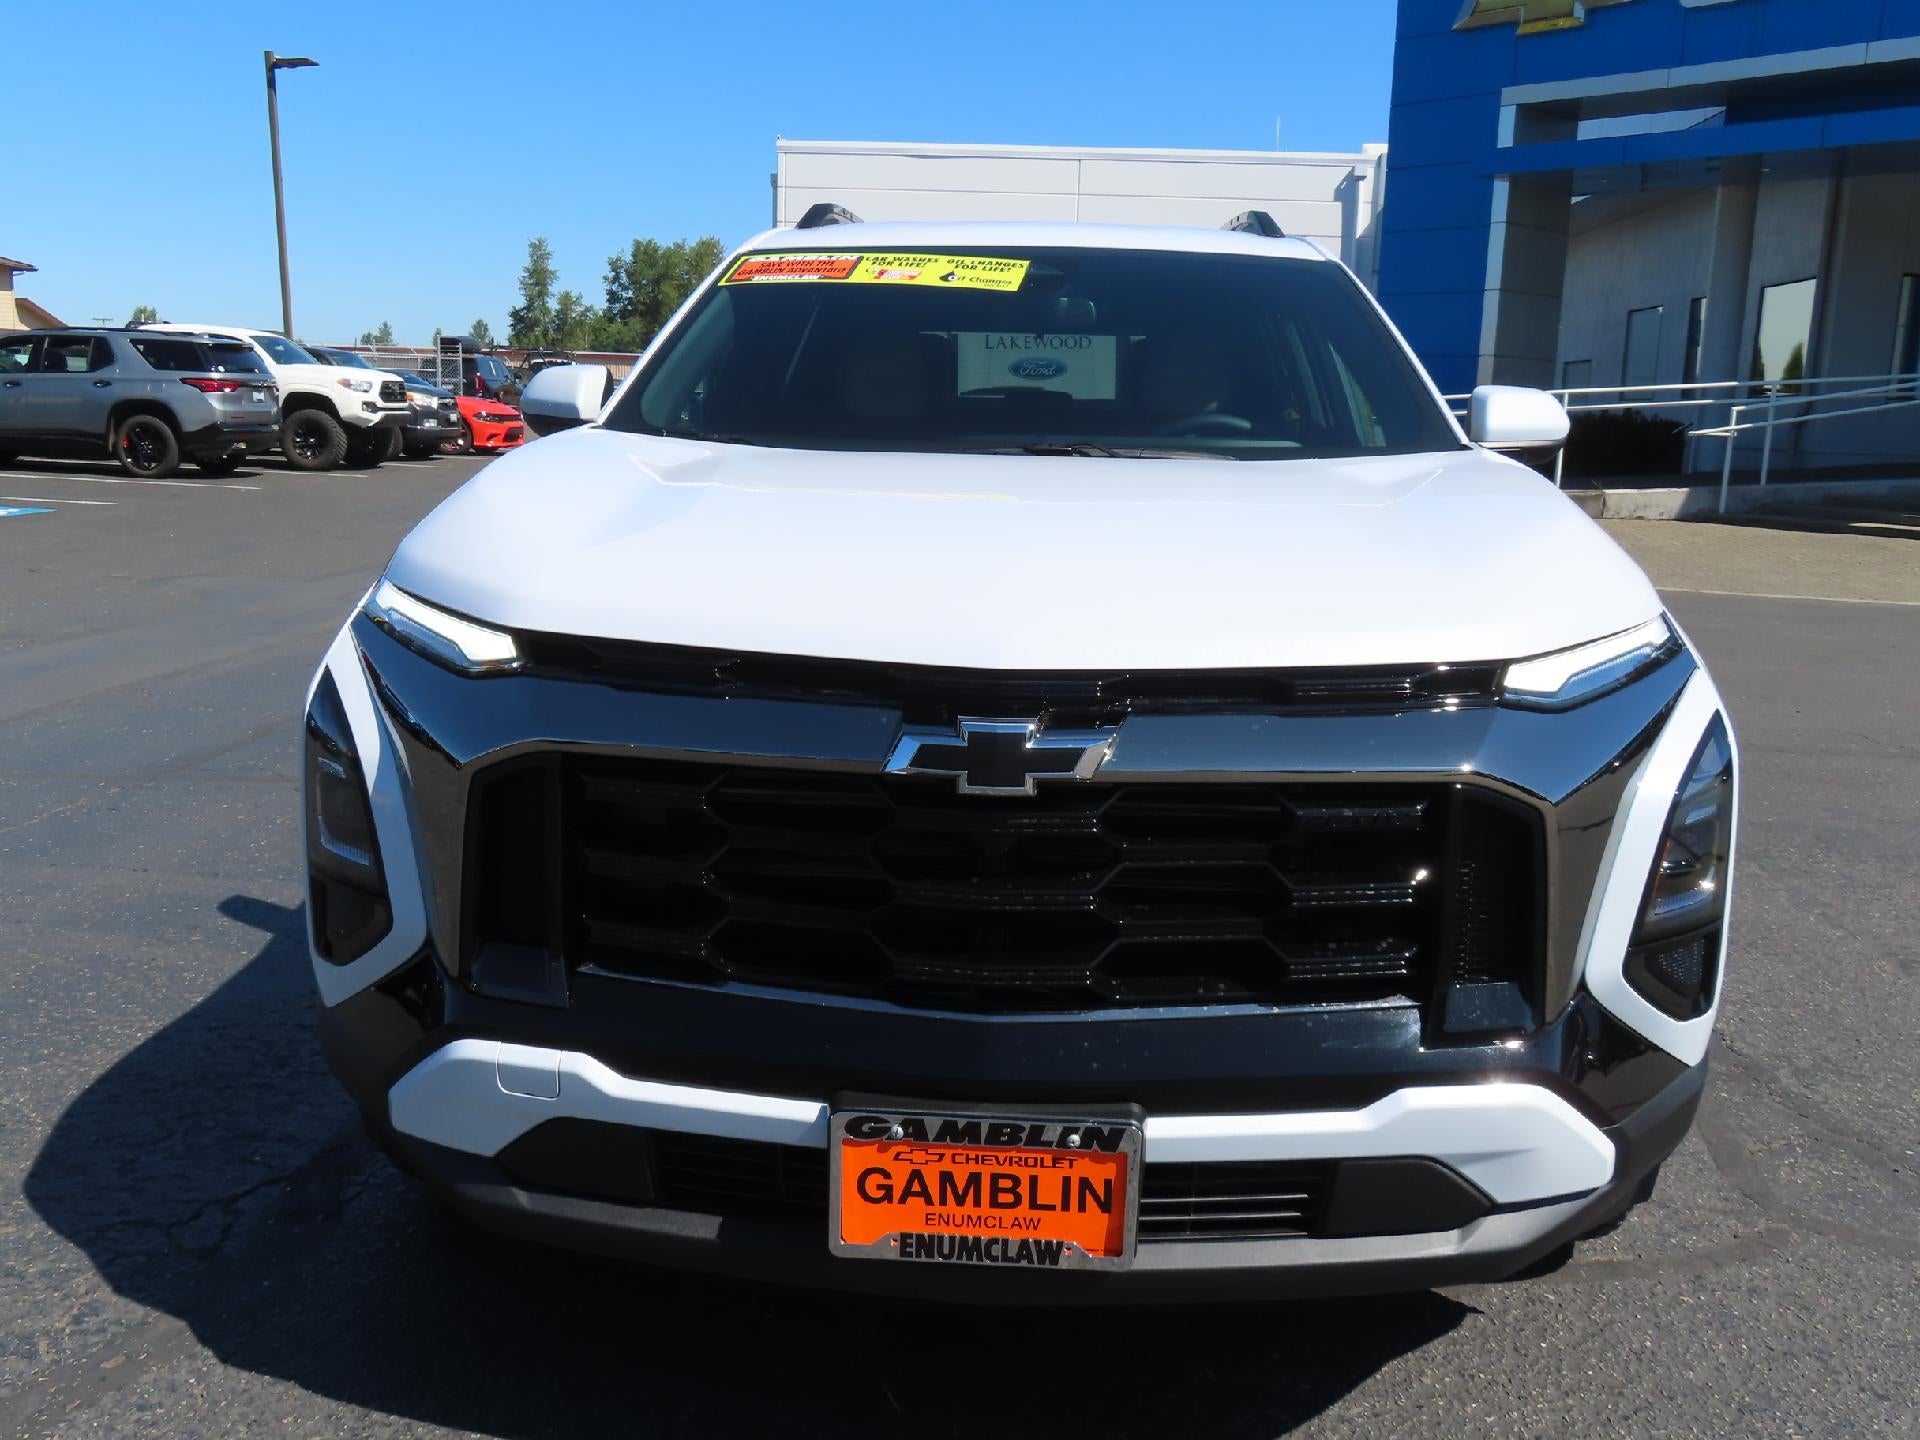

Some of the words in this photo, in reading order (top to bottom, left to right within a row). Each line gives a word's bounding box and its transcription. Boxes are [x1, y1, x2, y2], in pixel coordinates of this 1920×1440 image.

[971, 260, 1025, 268] CHANGES
[984, 334, 1092, 350] LAKEWOOD
[1018, 361, 1057, 376] Ford
[844, 1115, 1126, 1153] GAMBLIN
[951, 1152, 1079, 1170] CHEVROLET
[856, 1167, 1114, 1214] GAMBLIN
[924, 1212, 1042, 1231] ENUMCLAW
[898, 1232, 1065, 1267] ENUMCLAW
